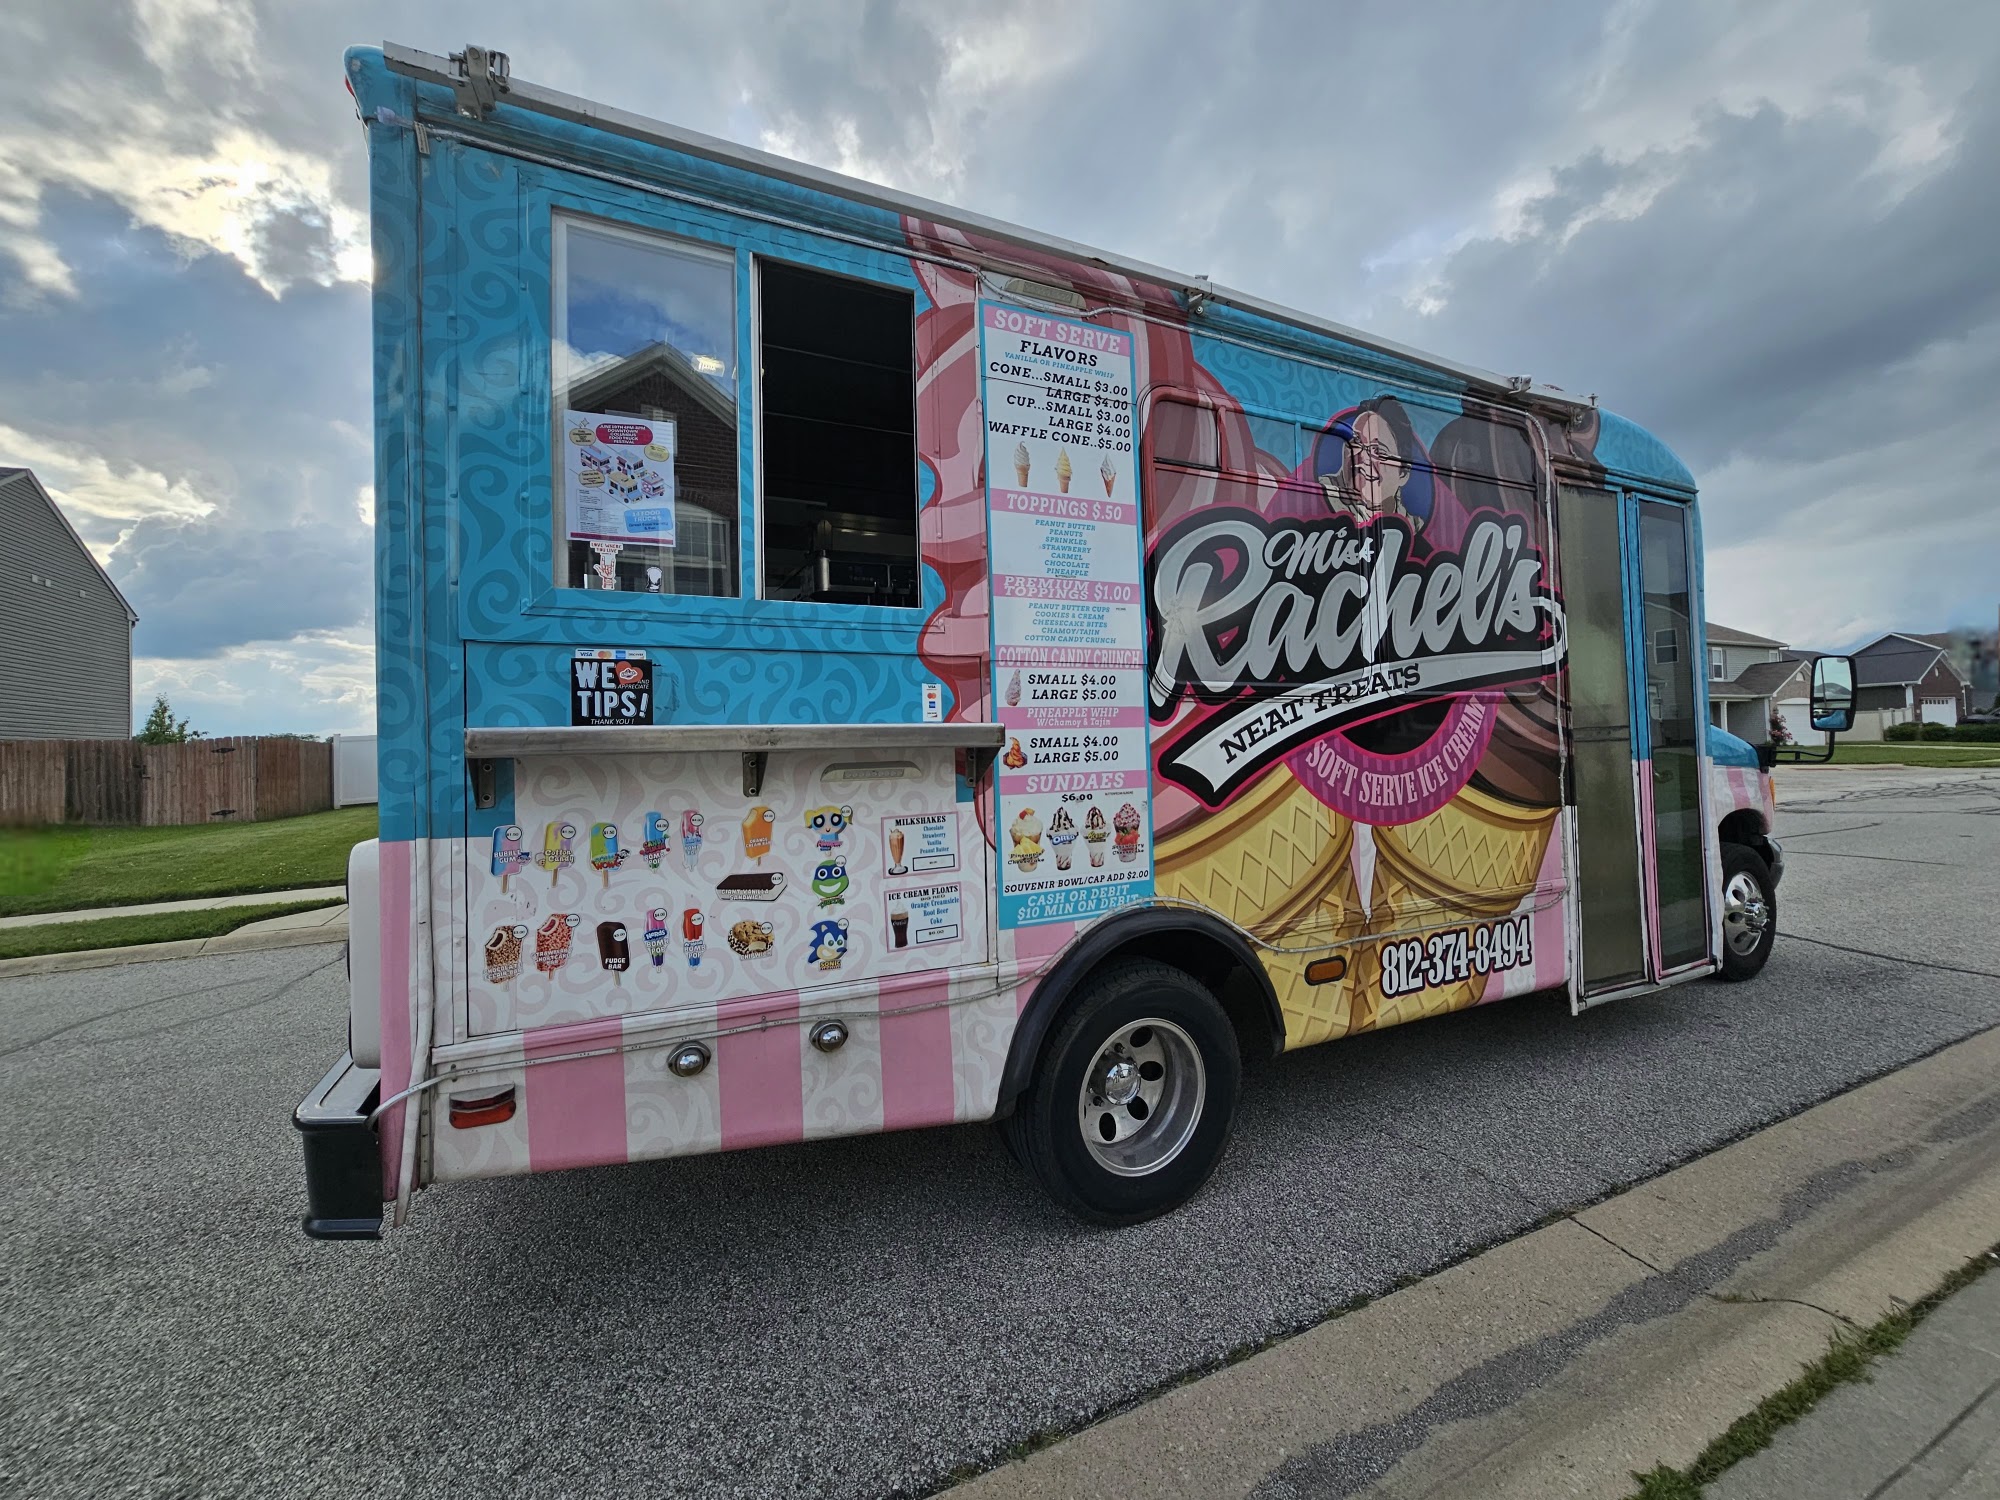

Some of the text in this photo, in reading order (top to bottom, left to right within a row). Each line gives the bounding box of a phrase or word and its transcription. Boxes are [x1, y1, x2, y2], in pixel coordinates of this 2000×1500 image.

[994, 310, 1120, 353] SOFT SERVE
[1020, 340, 1098, 366] FLAVORS
[1005, 352, 1115, 378] VANILLA OR PINEAPPLE WHIP
[990, 362, 1128, 396] CONE...SMALL $3.00
[1046, 387, 1128, 410] LARGE $4.00
[1007, 394, 1130, 424] CUP...SMALL $3.00
[988, 420, 1048, 440] WAFFLE
[1049, 416, 1130, 438] LARGE $4.00
[1007, 494, 1122, 520] TOPPINGS $.50
[1035, 519, 1096, 531] PEANUT BUTTER
[1049, 529, 1083, 538] PEANUTS
[1042, 544, 1092, 554] STRAWBERRY
[1045, 536, 1087, 546] SPRINKLES
[1051, 552, 1083, 560] CARMEL
[1264, 527, 1374, 580] Miss
[1044, 560, 1090, 569] CHOCOLATE
[1046, 568, 1089, 576] PINEAPPLE
[1004, 576, 1090, 591] PREMIUM
[1004, 582, 1131, 601] TOPPINGS $1.00
[1062, 604, 1090, 612] BUTTER
[1150, 521, 1542, 707] Rachel's
[1032, 619, 1084, 627] CHEESECAKE
[999, 646, 1140, 669] COTTON CANDY CRUNCH
[575, 662, 616, 689] WE
[1028, 674, 1116, 686] SMALL $4.00
[1032, 688, 1116, 701] LARGE $5.00
[577, 691, 649, 718] TIPS!
[1027, 708, 1119, 718] PINEAPPLE WHIP
[1037, 718, 1081, 727] W/Chamoy
[1091, 718, 1110, 727] Tajin
[1220, 664, 1421, 764] NEAT TREATS
[1030, 736, 1118, 748] SMALL $4.00
[1034, 751, 1119, 763] LARGE $5.00
[1306, 695, 1485, 807] SOFT SERVE ICE CREAM
[1026, 773, 1125, 793] SUNDAES
[1062, 794, 1093, 802] $6.00
[895, 816, 946, 826] MILKSHAKES
[1052, 834, 1075, 843] OREO
[548, 855, 574, 863] Candy
[1004, 870, 1149, 893] SOUVENIR BOWL/CAP ADD $2.00
[888, 886, 958, 900] ICE CREAM FLOATS
[931, 897, 959, 906] Creamsicle
[1028, 884, 1129, 906] CASH OR DEBIT
[1018, 907, 1040, 921] $10
[1044, 903, 1072, 916] MIN
[1078, 899, 1095, 911] ON
[1382, 918, 1531, 995] 812-374-8494
